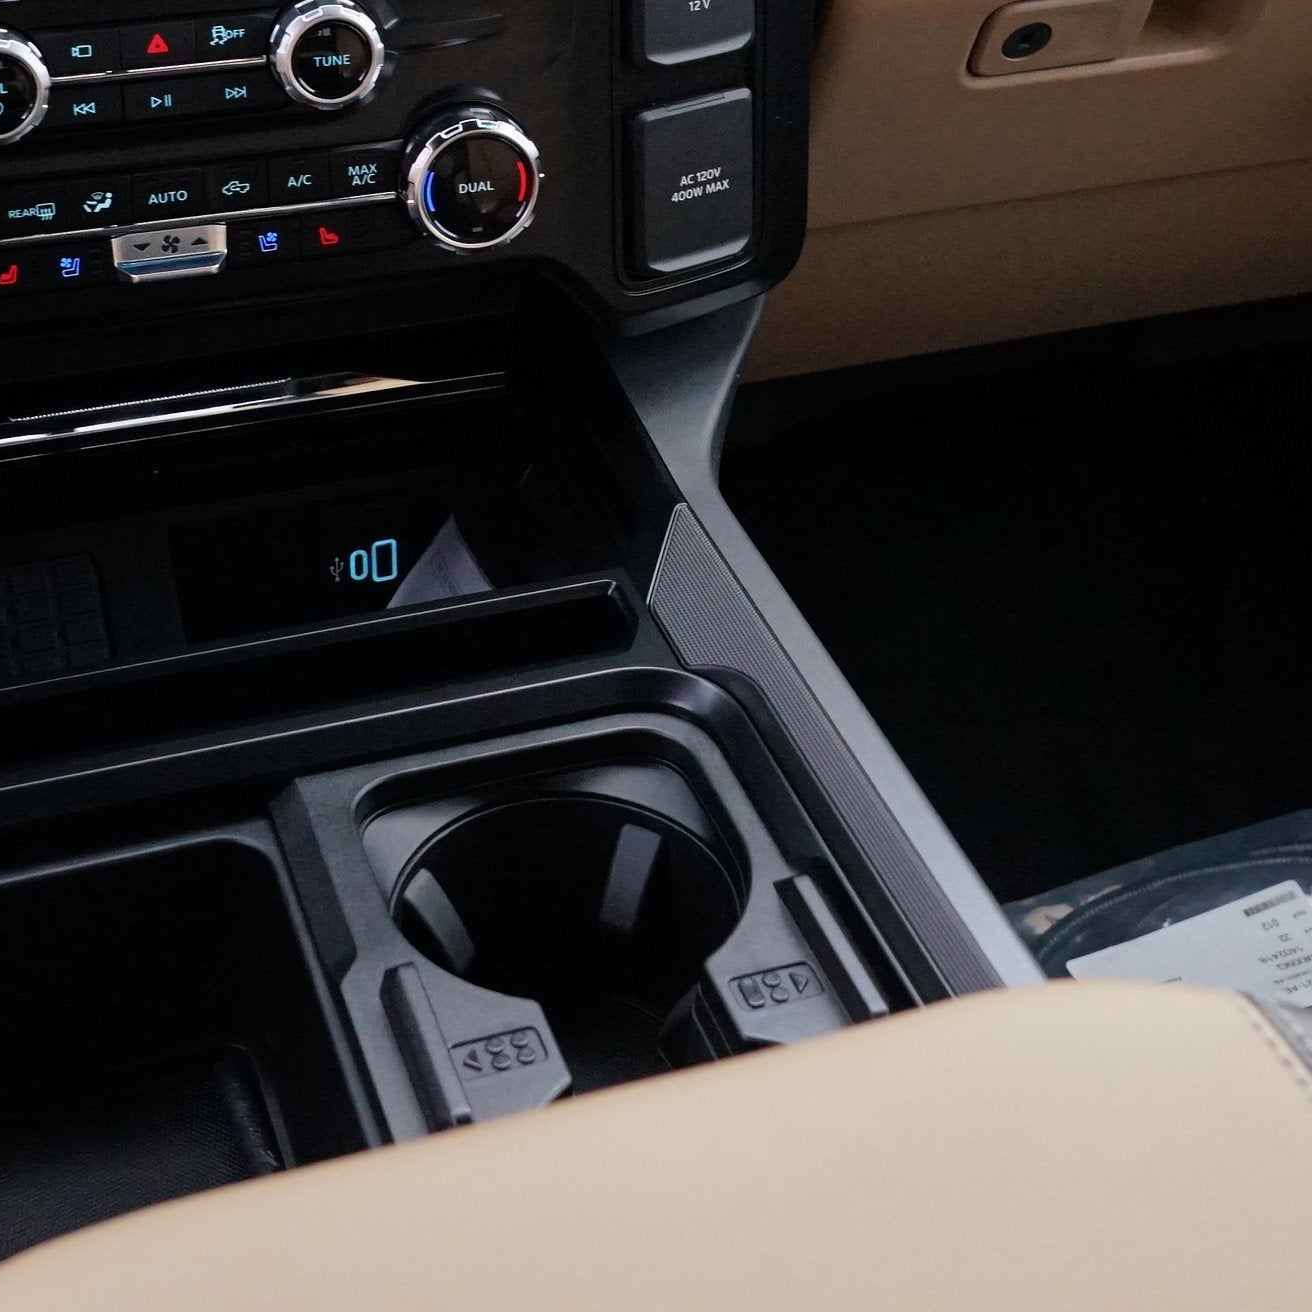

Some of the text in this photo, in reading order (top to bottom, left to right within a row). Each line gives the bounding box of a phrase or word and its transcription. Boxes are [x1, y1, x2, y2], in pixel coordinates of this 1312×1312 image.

[688, 0, 701, 13] 12
[225, 28, 246, 40] OFF
[313, 53, 352, 68] TUNE
[348, 162, 378, 177] MAX
[680, 166, 722, 188] AC 120V
[287, 173, 313, 188] A/C
[351, 173, 377, 187] A/C
[457, 179, 496, 195] DUAL
[147, 189, 189, 206] AUTO
[671, 178, 730, 203] 400W MAX
[7, 205, 37, 220] REAR
